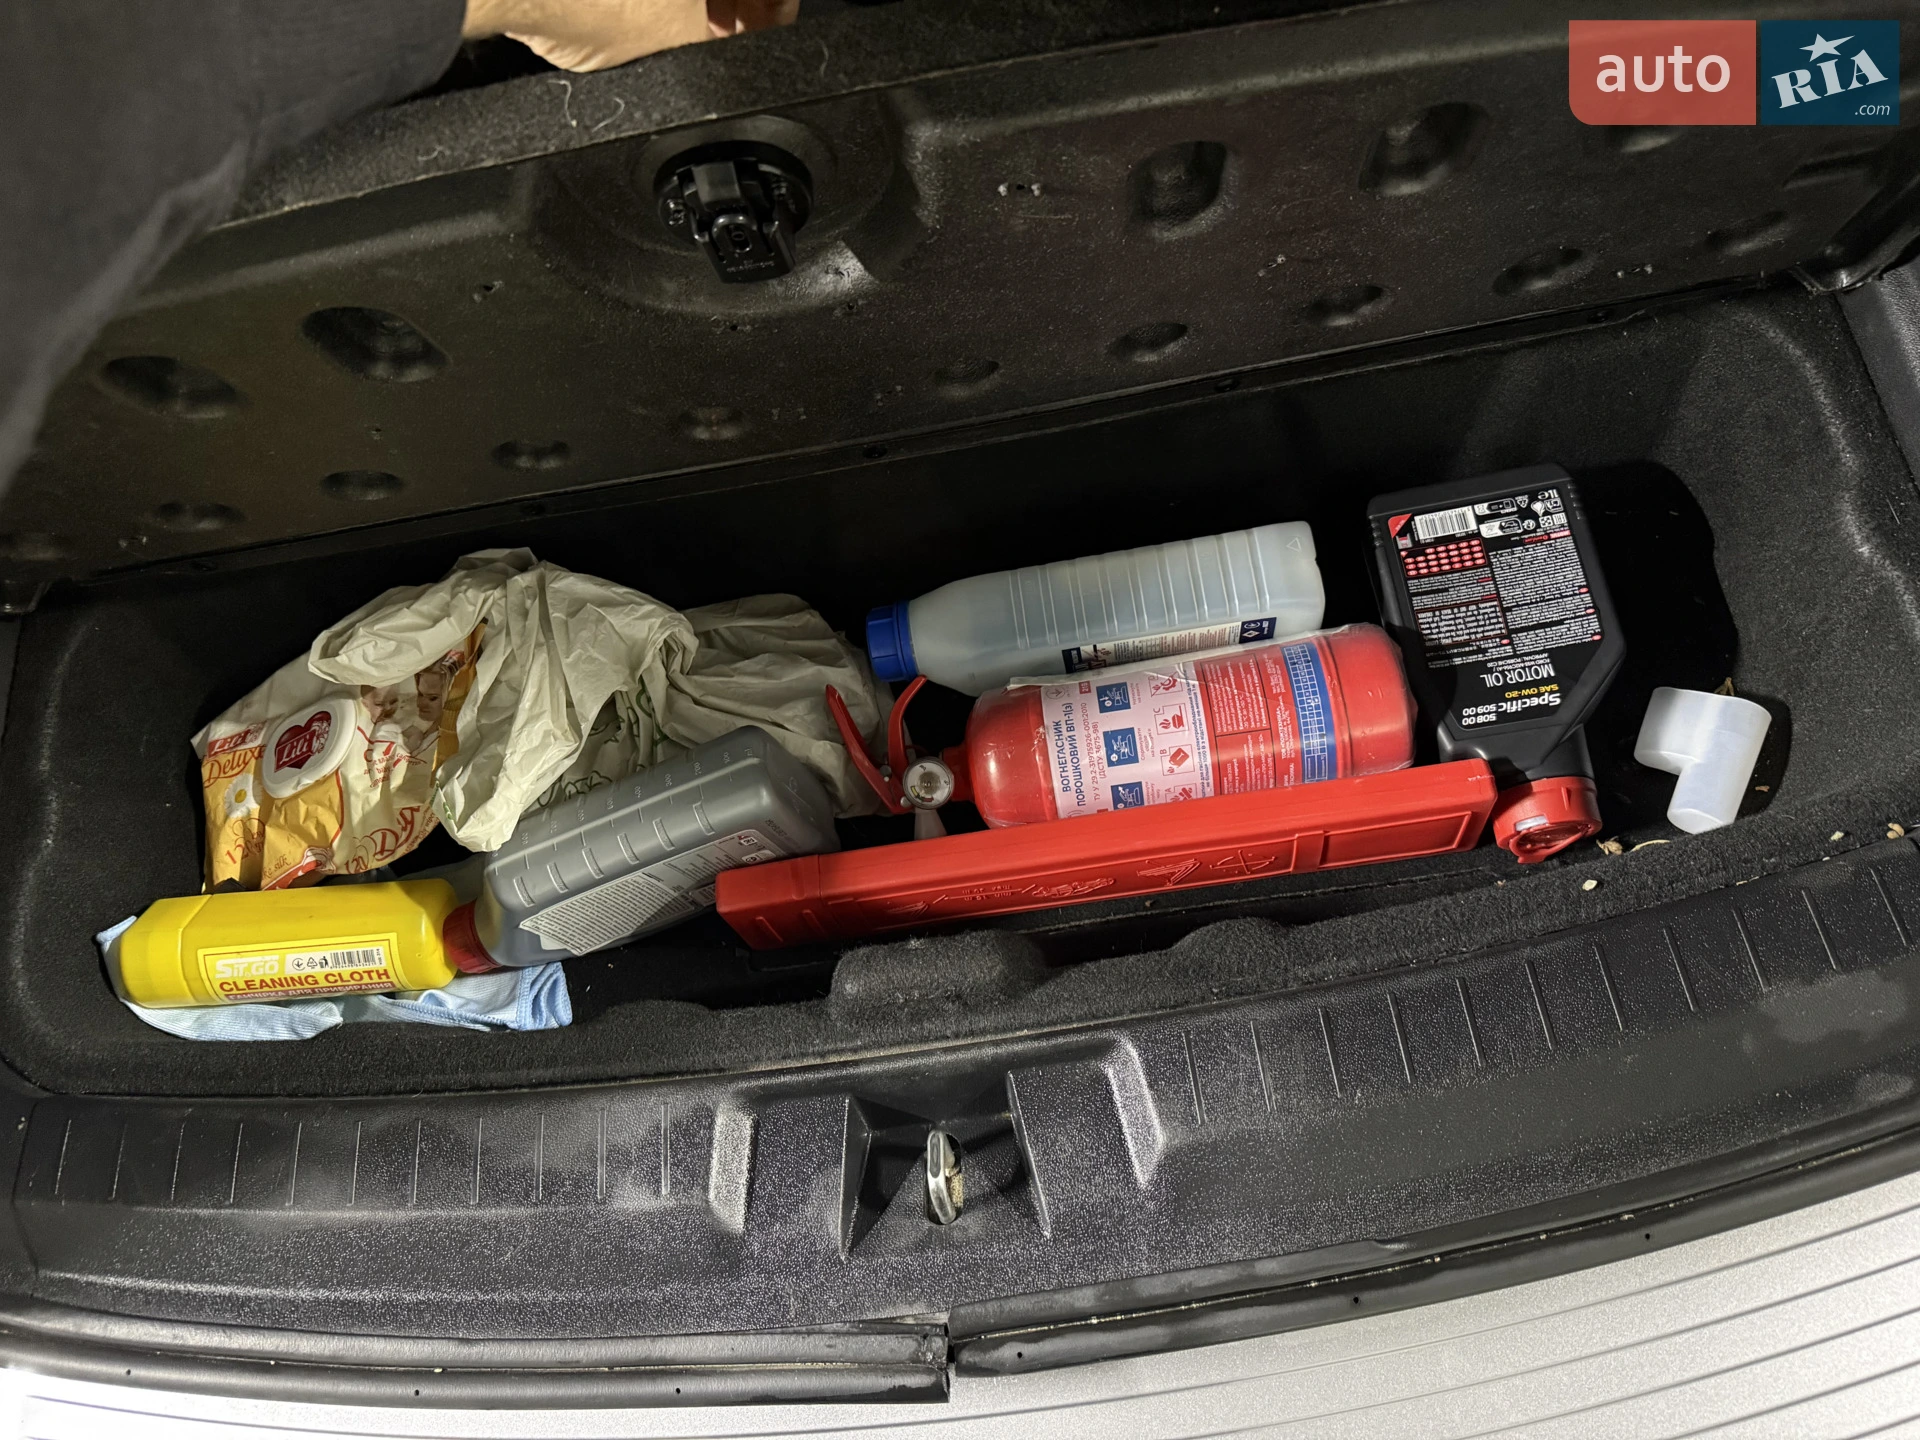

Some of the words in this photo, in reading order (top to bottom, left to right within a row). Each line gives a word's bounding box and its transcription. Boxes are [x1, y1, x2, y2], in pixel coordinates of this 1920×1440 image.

[1480, 671, 1503, 688] OIL
[1506, 663, 1555, 685] MOTOR
[1505, 687, 1537, 699] 0W-20
[1539, 683, 1559, 695] SAE
[1462, 706, 1476, 716] 00
[1477, 703, 1497, 714] 509
[1498, 691, 1561, 714] Specific
[1462, 716, 1476, 725] 00
[1477, 713, 1497, 724] 508
[276, 734, 312, 763] Lili
[1052, 719, 1071, 792] ВОГНЕГАСНИК
[1065, 734, 1086, 806] ПОРОШКОВИЙ
[1096, 755, 1106, 779] (ДСТУ
[219, 973, 318, 993] CLEANING
[324, 968, 390, 984] CLOTH
